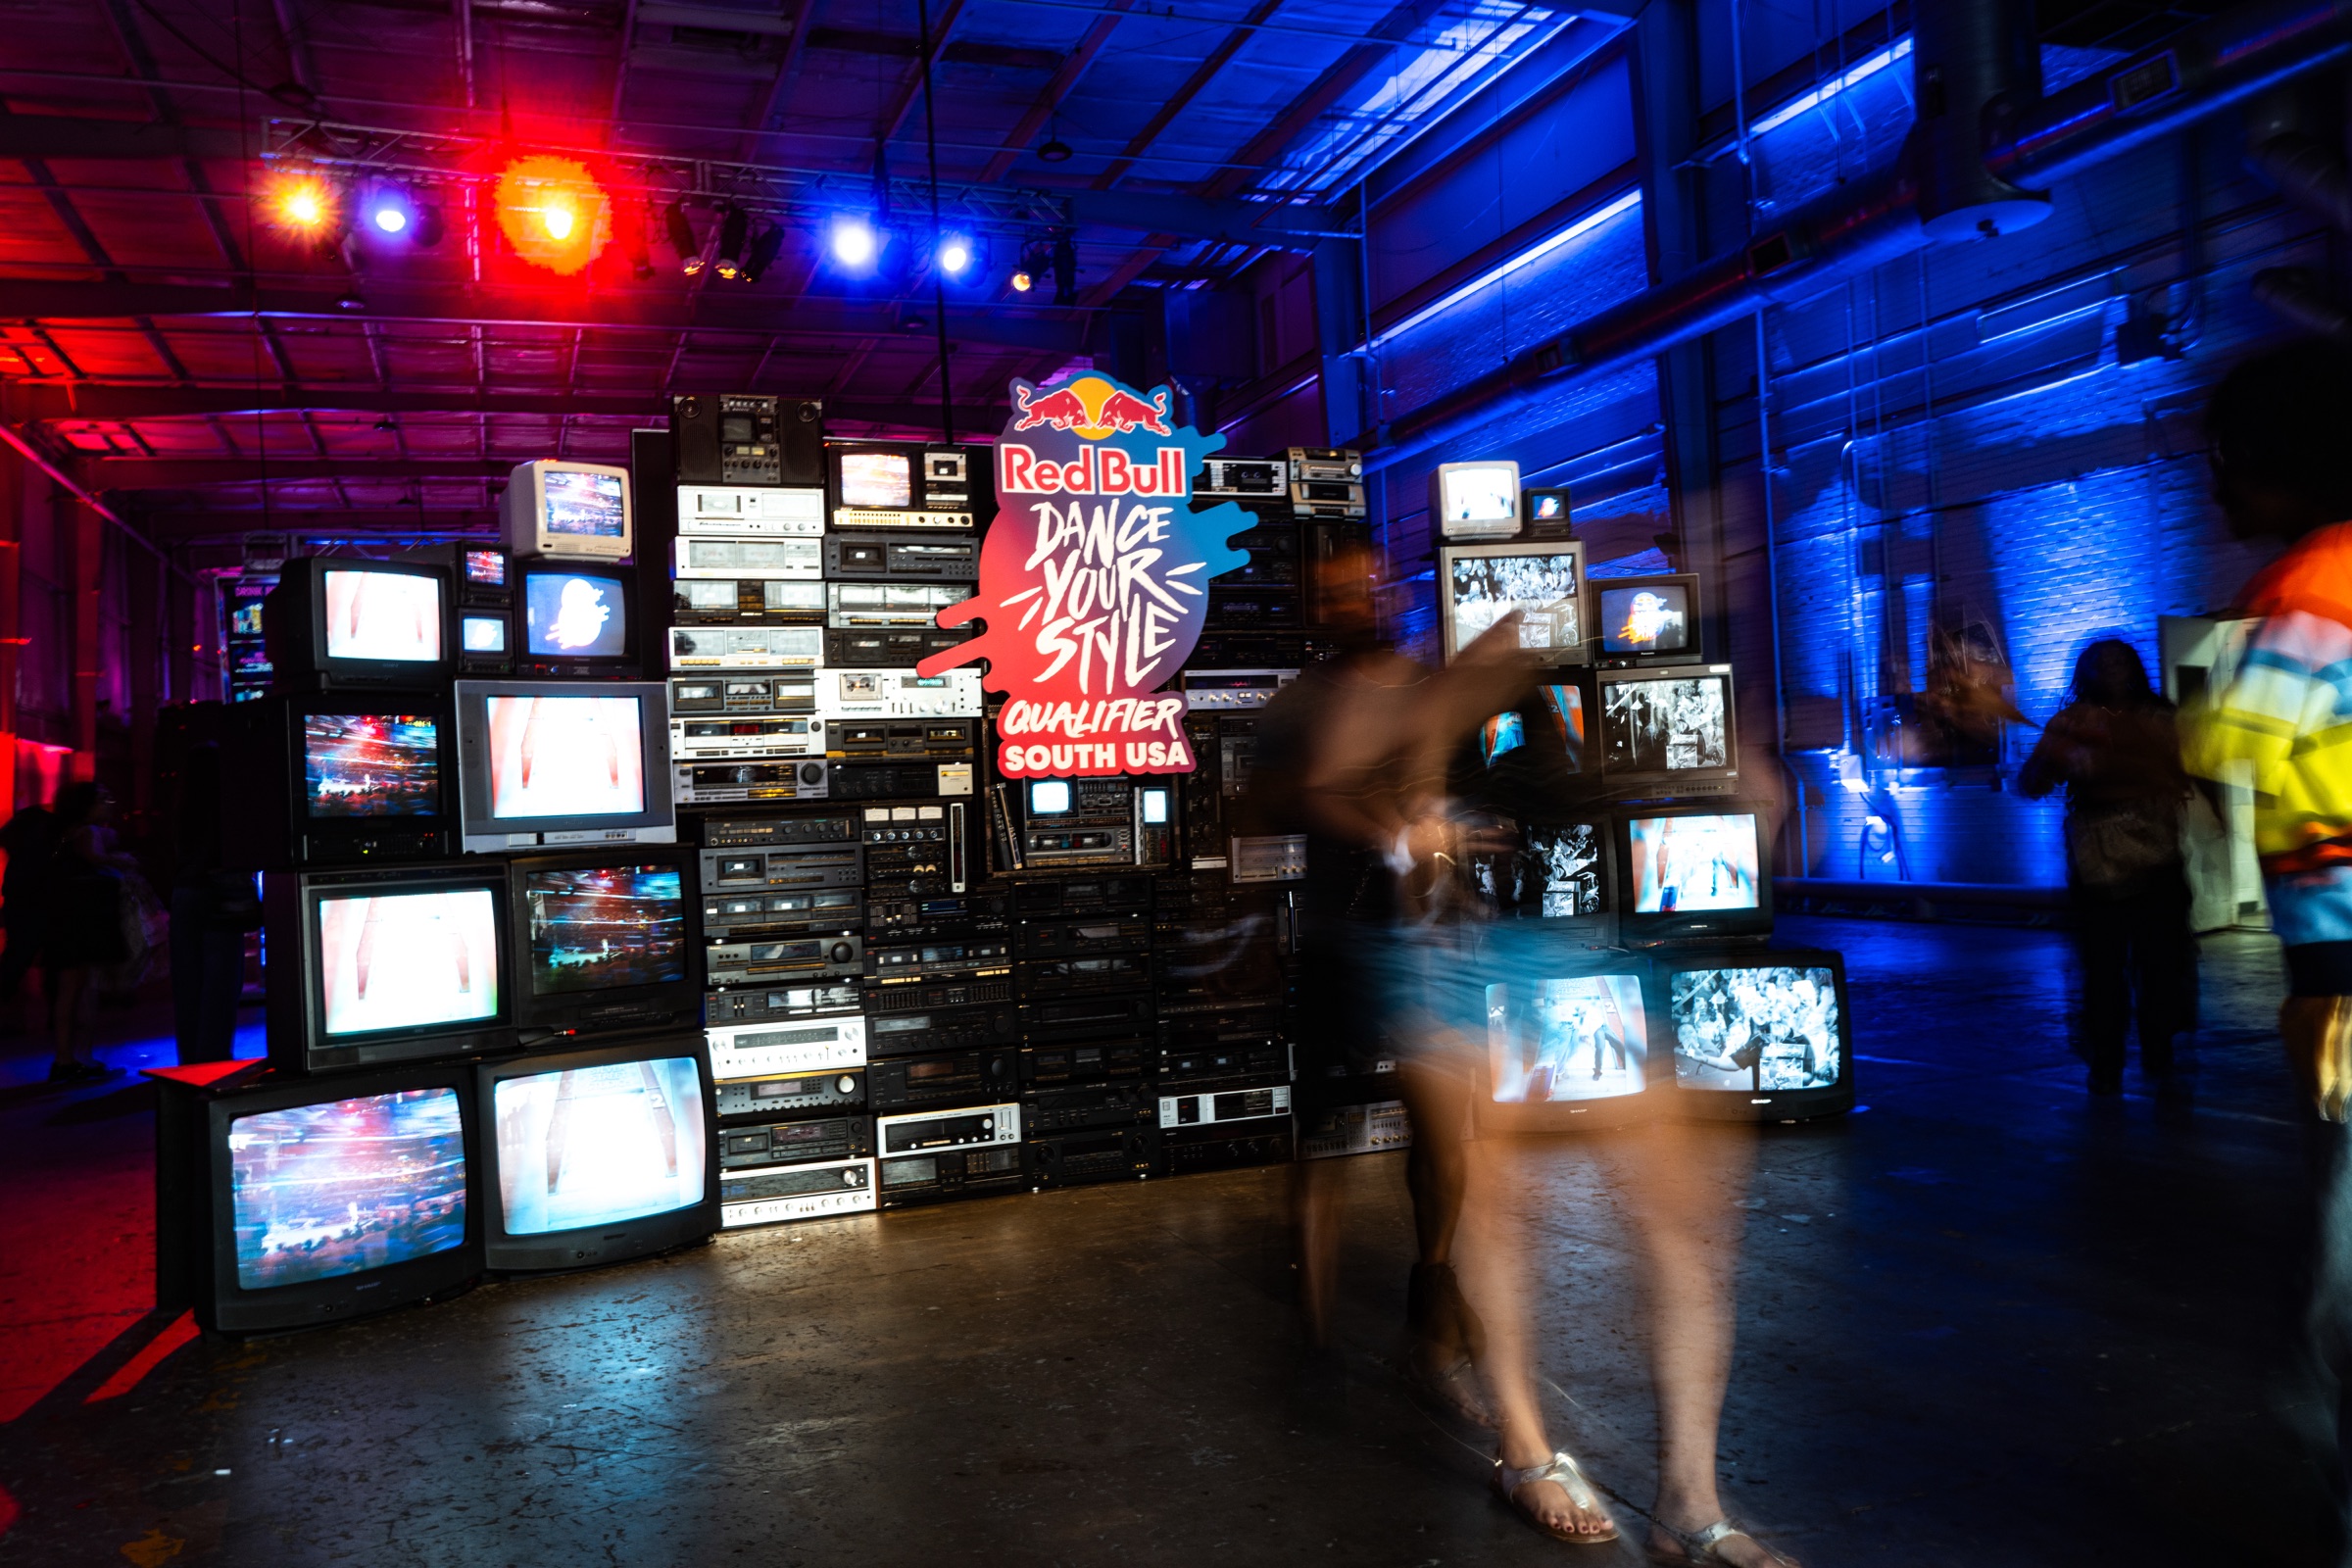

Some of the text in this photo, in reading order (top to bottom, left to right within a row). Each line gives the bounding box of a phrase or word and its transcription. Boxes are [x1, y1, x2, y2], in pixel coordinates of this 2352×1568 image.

[1002, 445, 1186, 496] Red Bull
[1026, 499, 1174, 571] DANCE
[1042, 549, 1188, 626] YOUR
[1033, 594, 1177, 695] STYLE
[1004, 698, 1184, 739] QUALIFIER
[1004, 741, 1190, 772] SOUTH USA
[651, 1094, 665, 1108] 2
